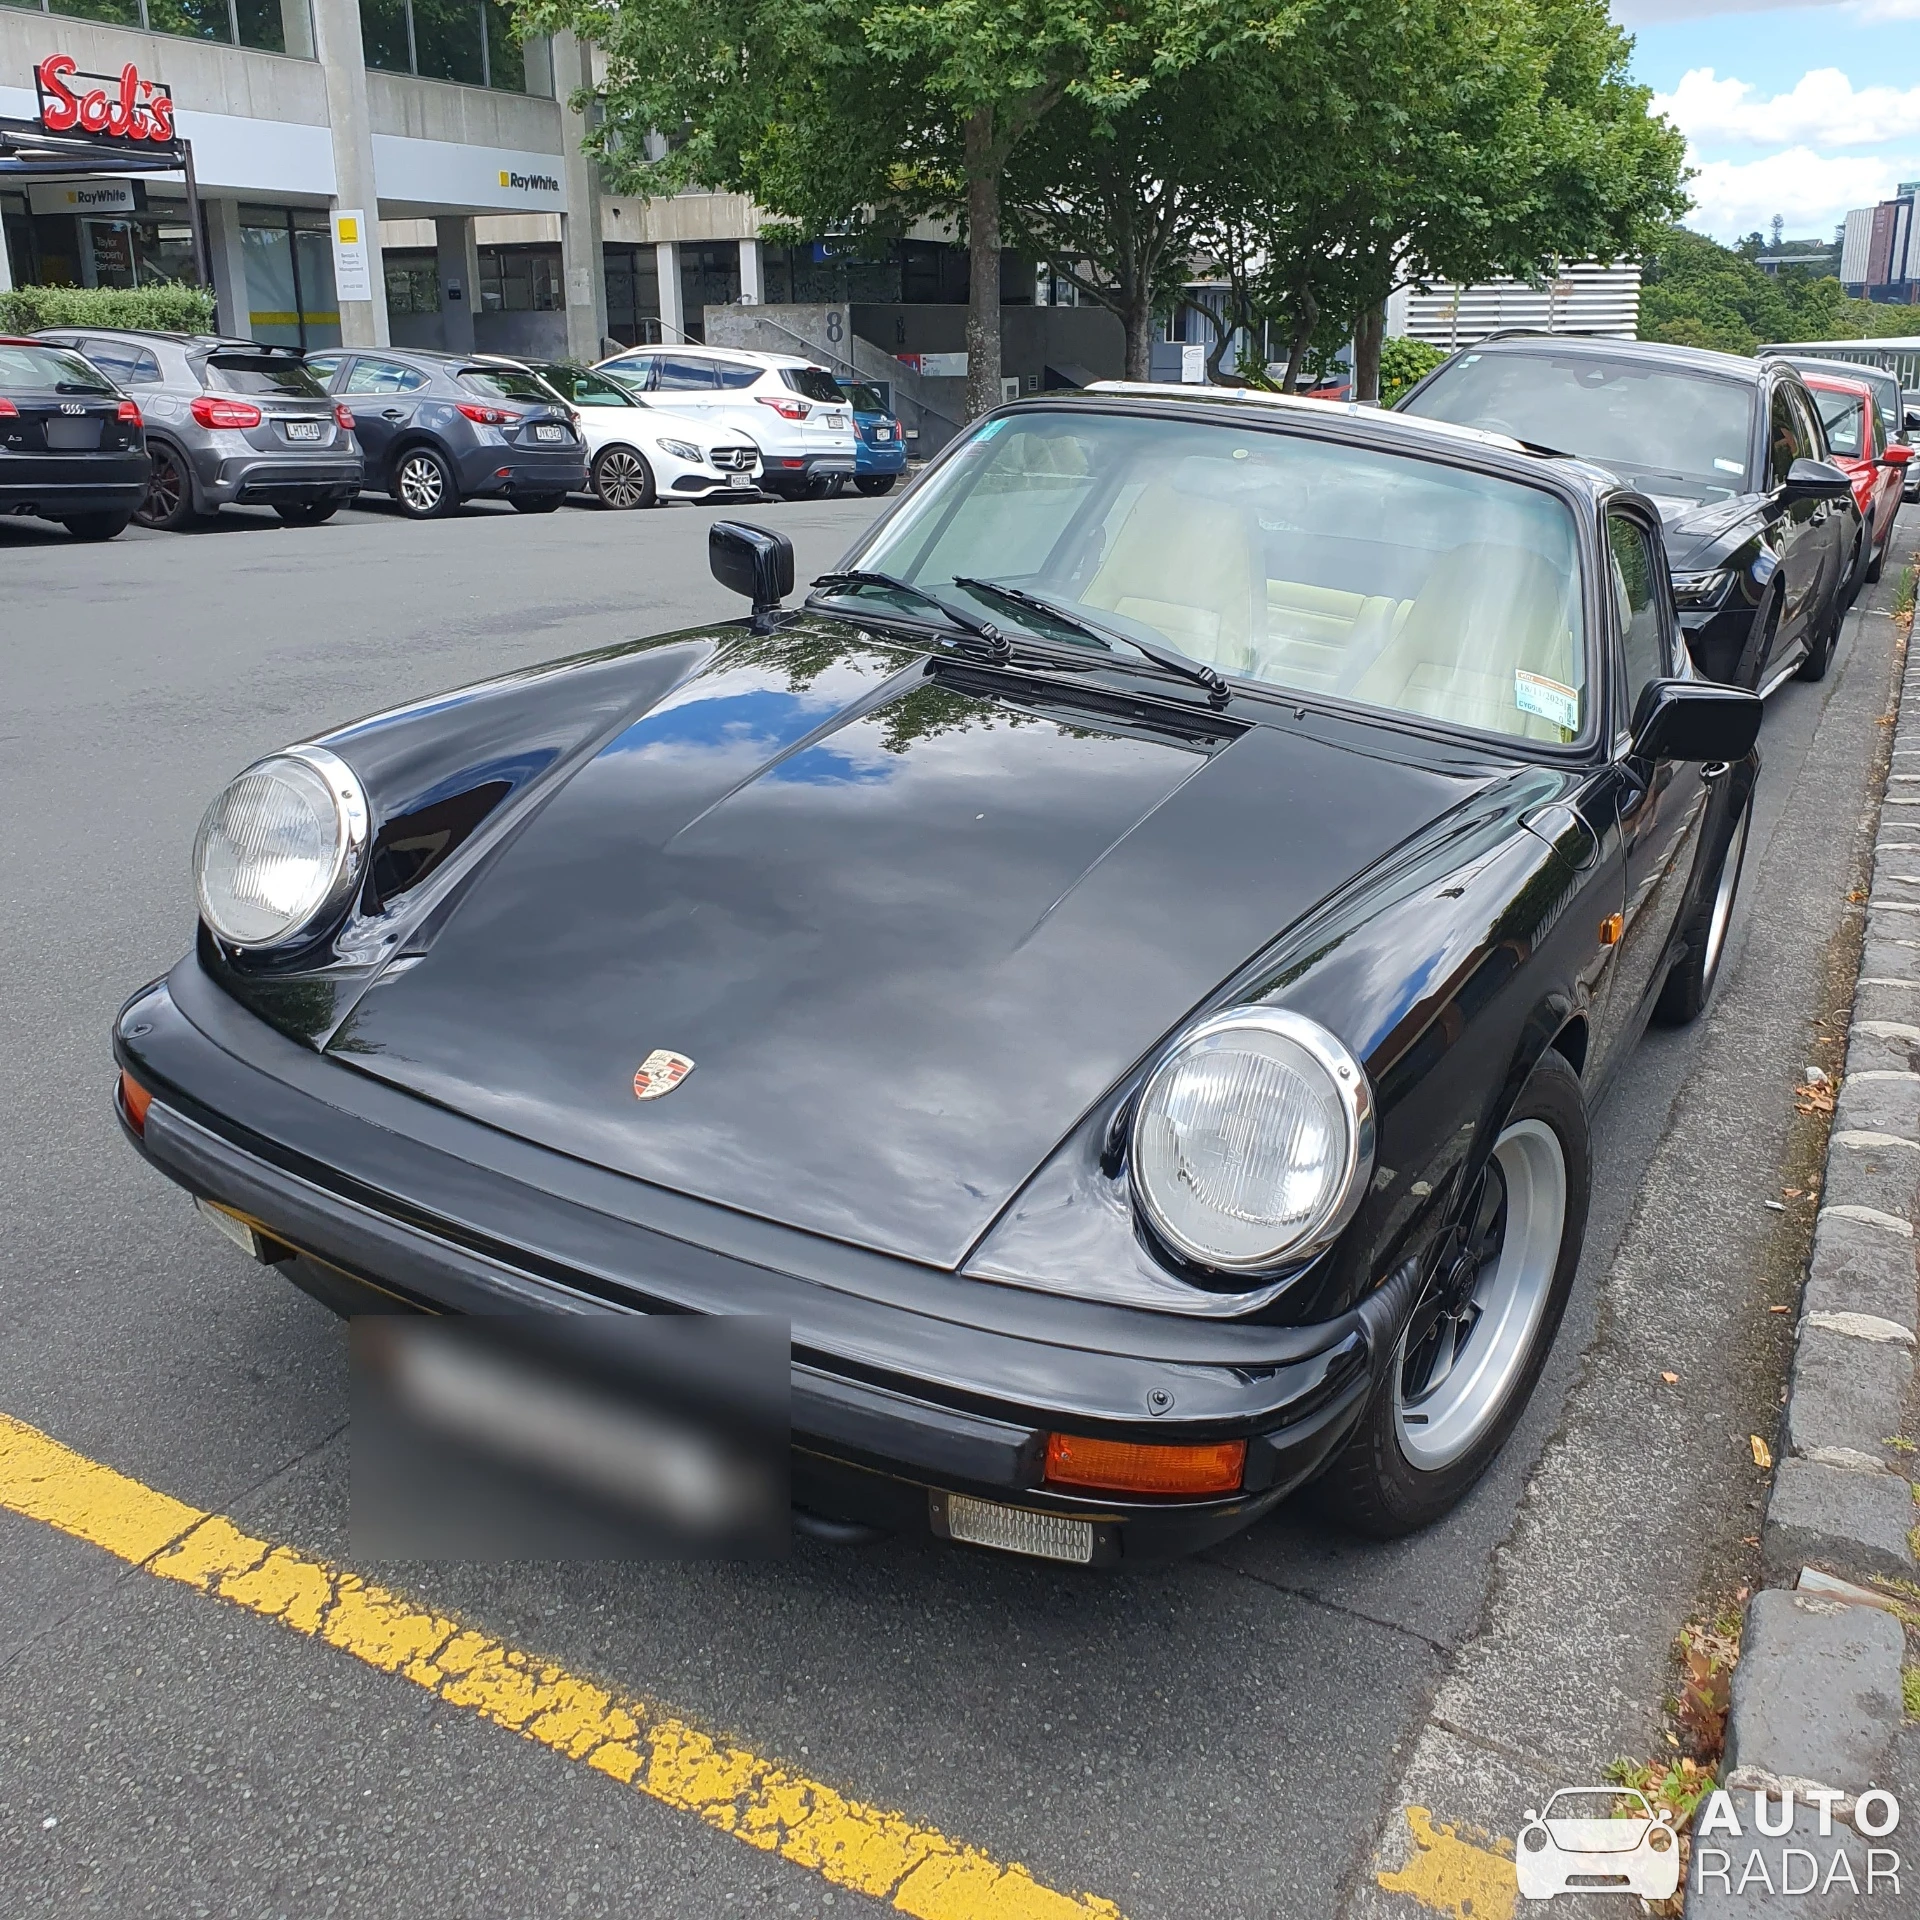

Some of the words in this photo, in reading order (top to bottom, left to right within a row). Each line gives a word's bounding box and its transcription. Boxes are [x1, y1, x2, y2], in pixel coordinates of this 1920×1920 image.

[39, 53, 174, 141] Sal's
[96, 236, 118, 248] Taylor
[93, 248, 124, 260] Property
[95, 261, 126, 272] Services
[826, 311, 844, 343] 8
[288, 424, 319, 436] LHT344
